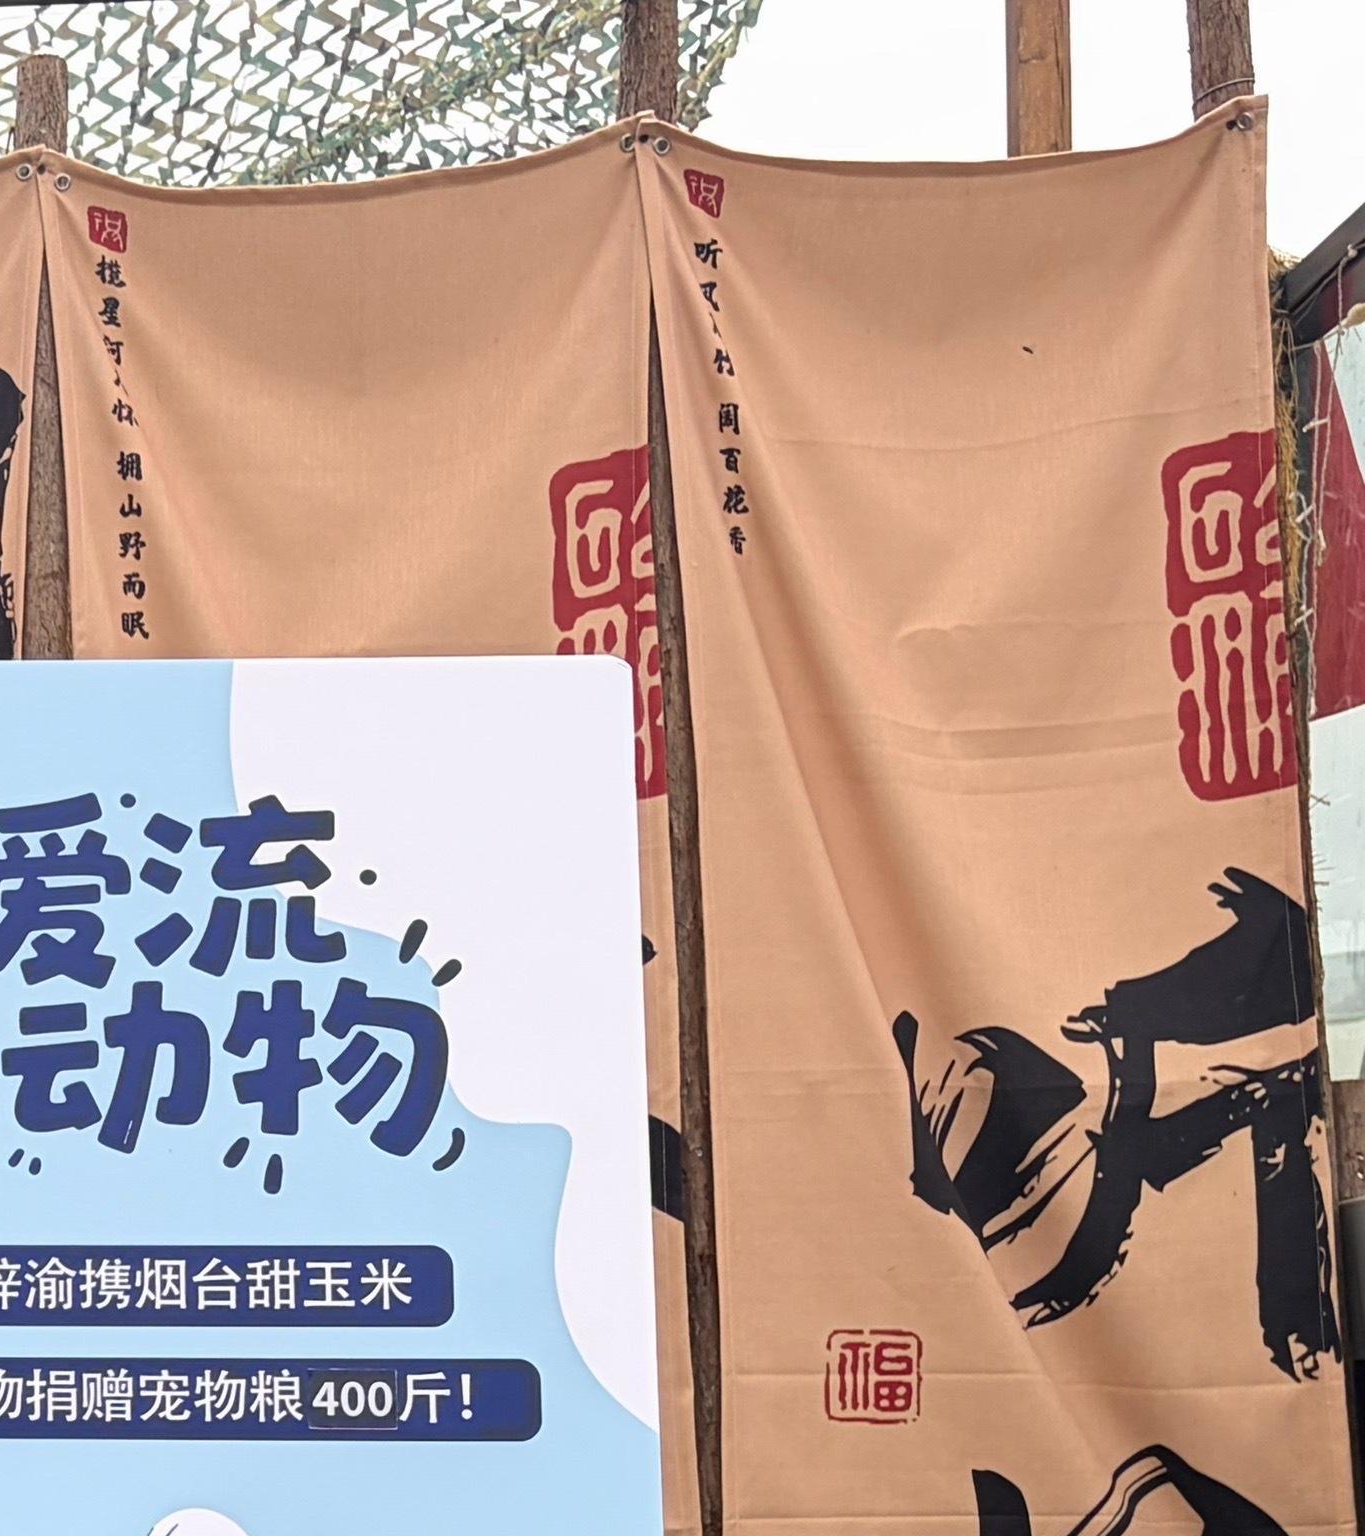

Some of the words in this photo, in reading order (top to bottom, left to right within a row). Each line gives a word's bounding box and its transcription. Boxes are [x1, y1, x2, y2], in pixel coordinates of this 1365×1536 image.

[94, 255, 139, 427] 揽星河怀
[693, 238, 736, 378] 听风竹
[116, 450, 150, 641] 拥山野而眠
